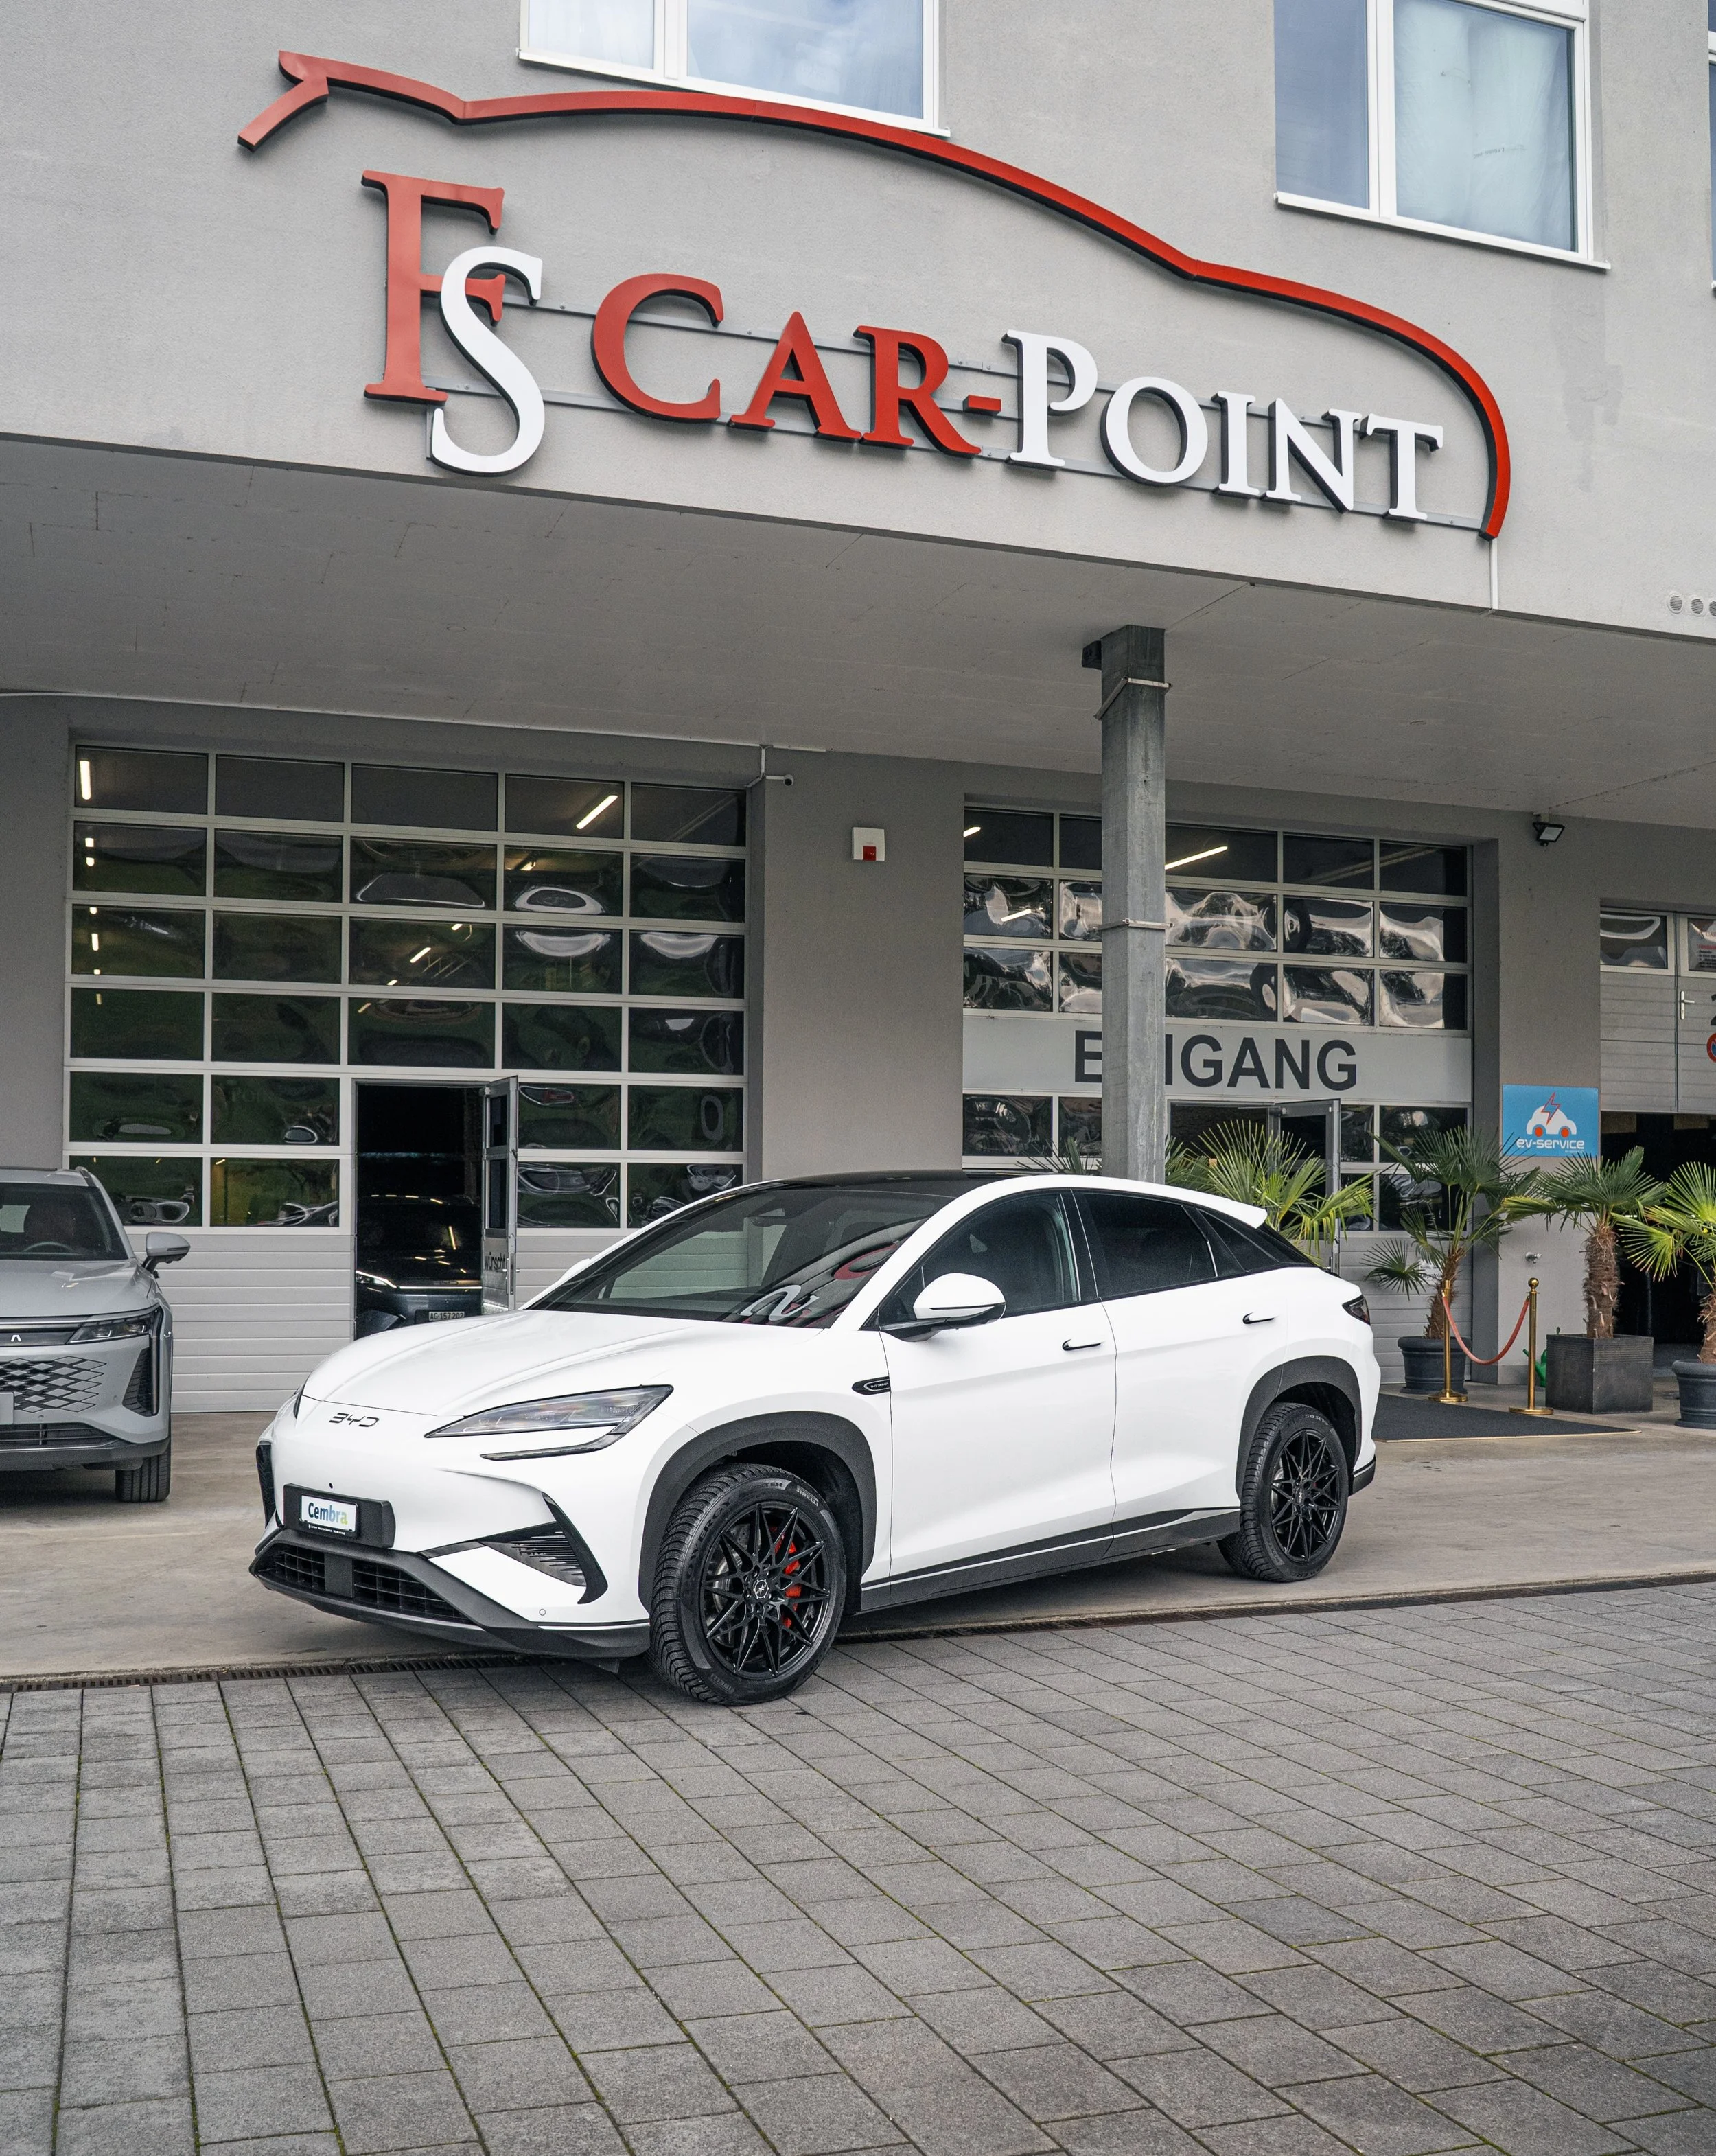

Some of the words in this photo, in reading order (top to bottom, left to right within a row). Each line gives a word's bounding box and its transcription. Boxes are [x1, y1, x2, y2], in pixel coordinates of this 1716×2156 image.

[361, 170, 546, 477] FS
[1074, 1030, 1358, 1091] EGANG
[1516, 1139, 1585, 1150] ev-service
[328, 1412, 380, 1428] BYD
[308, 1502, 349, 1525] Cembra
